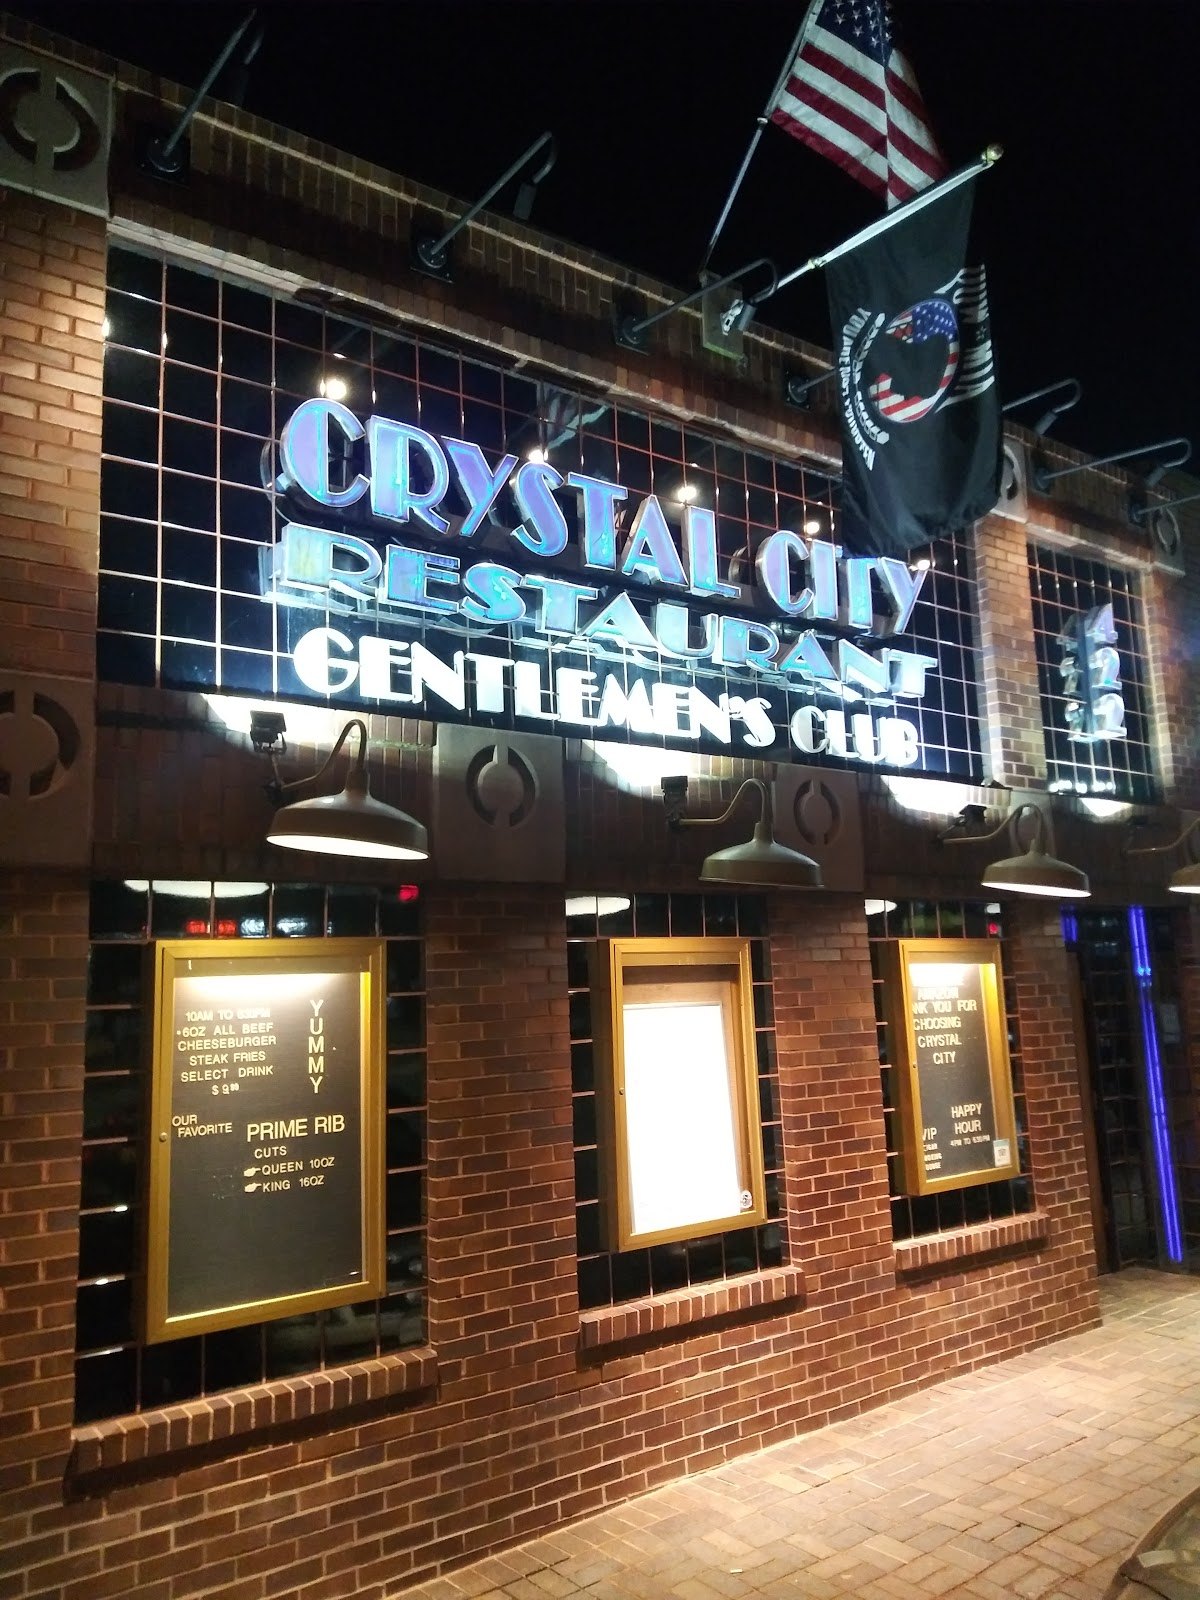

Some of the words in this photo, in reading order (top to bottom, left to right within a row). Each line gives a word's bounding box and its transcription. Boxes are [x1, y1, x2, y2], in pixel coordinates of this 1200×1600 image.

[843, 308, 872, 338] YOU
[280, 398, 741, 598] CRYSTAL
[756, 529, 930, 634] CITY
[282, 521, 938, 698] RESTAURANT
[293, 626, 776, 747] GENTLEMEN'S
[790, 705, 918, 766] CLUB
[933, 1001, 952, 1013] YOU
[958, 1000, 977, 1012] FOR
[186, 1010, 213, 1022] 10AM
[218, 1010, 233, 1021] TO
[214, 1024, 235, 1035] ALL
[242, 1023, 274, 1034] BEEF
[914, 1017, 961, 1030] CHOOSING
[178, 1036, 276, 1051] CHEESEBURGER
[308, 1000, 324, 1093] YUMMY
[918, 1033, 962, 1048] CRYSTAL
[189, 1054, 228, 1066] STEAK
[234, 1051, 265, 1063] FRIES
[933, 1051, 956, 1064] CITY
[181, 1069, 228, 1082] SELECT
[239, 1066, 273, 1077] DRINK
[951, 1103, 982, 1118] HAPPY
[172, 1115, 197, 1127] OUR
[955, 1120, 981, 1134] HOUR
[178, 1123, 232, 1137] FAVORITE
[247, 1119, 308, 1142] PRIME
[315, 1115, 345, 1134] RIB
[922, 1128, 937, 1140] VIP
[254, 1146, 287, 1159] CUTS
[262, 1161, 303, 1175] QUEEN
[263, 1180, 290, 1192] KING
